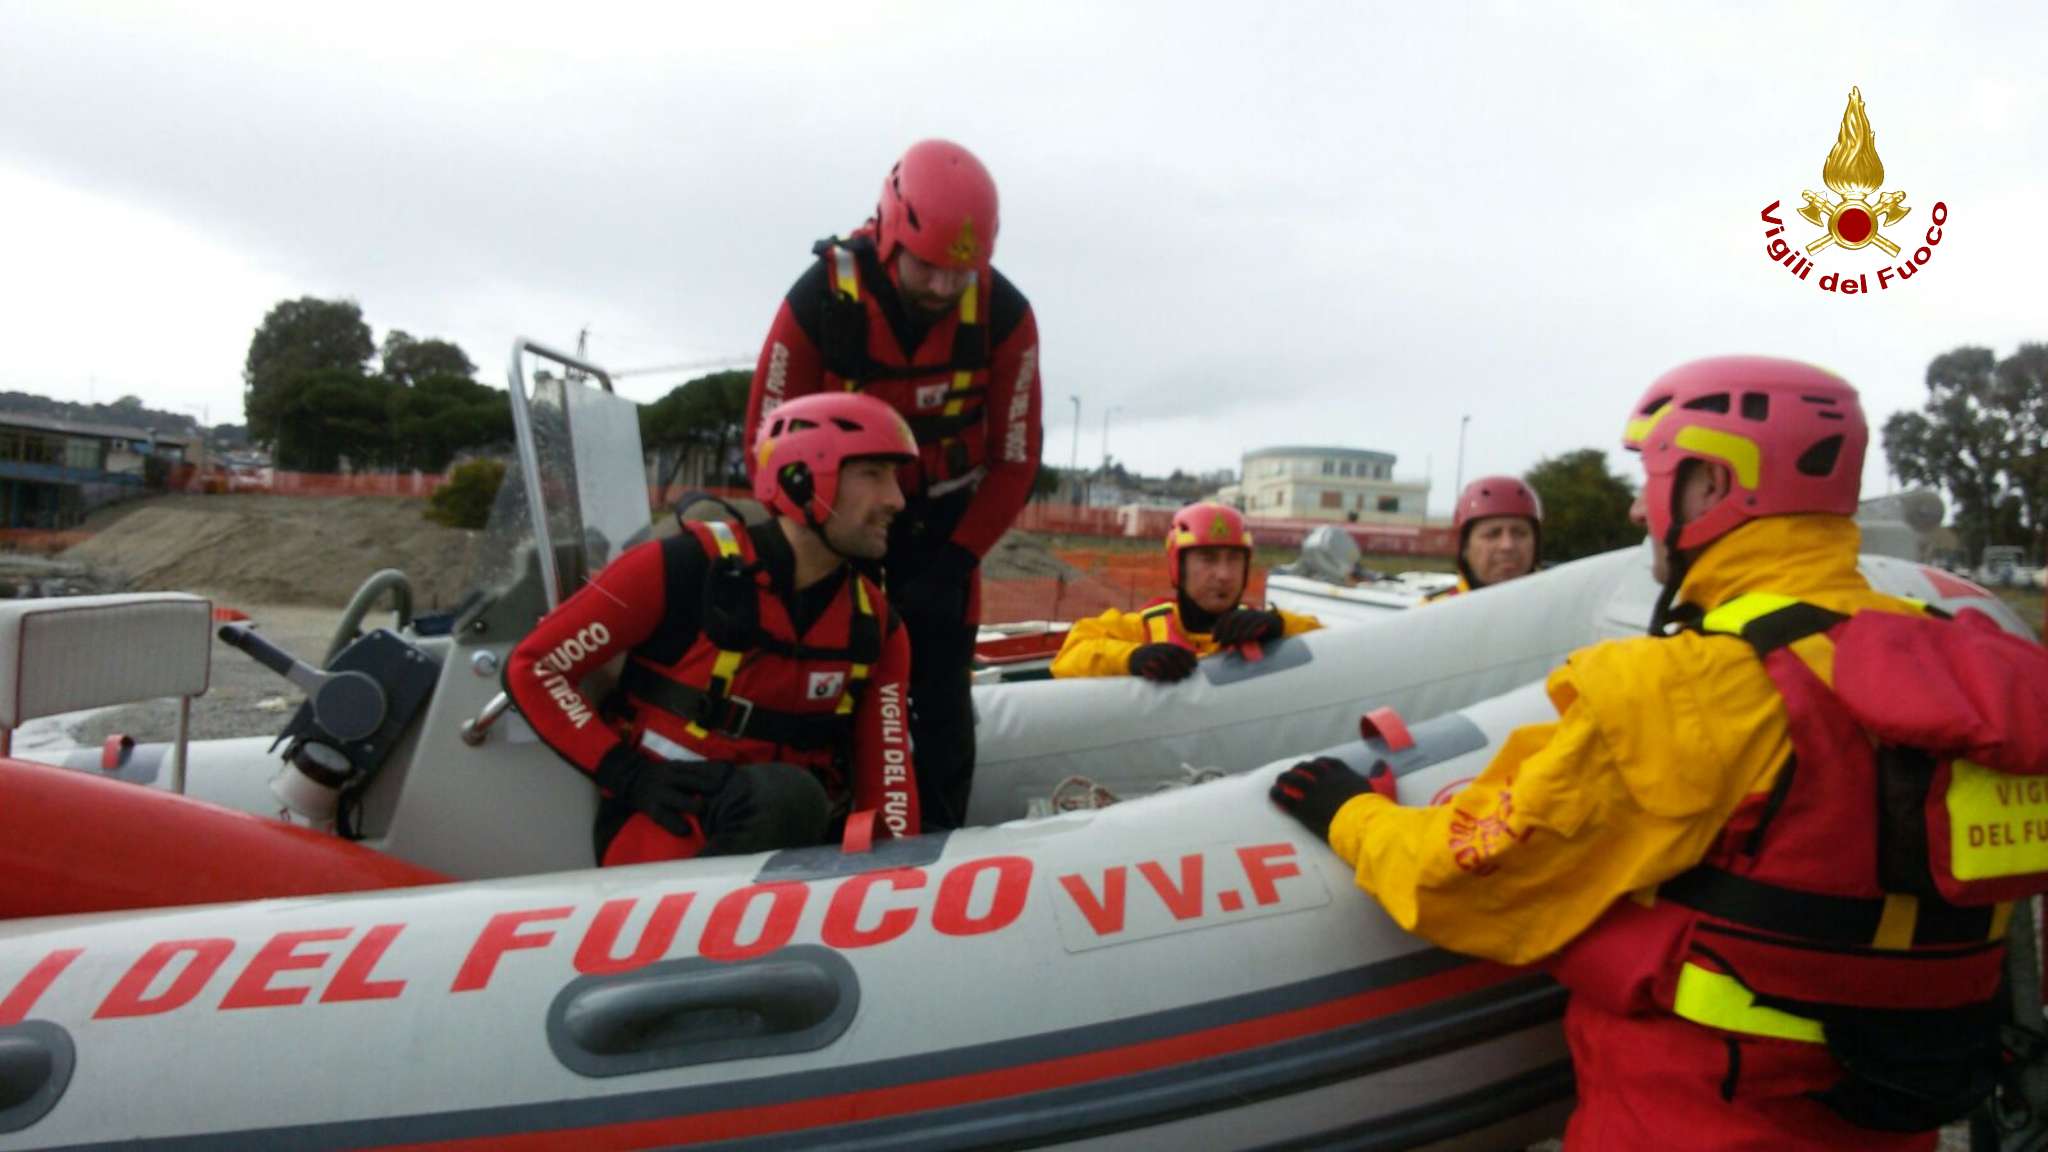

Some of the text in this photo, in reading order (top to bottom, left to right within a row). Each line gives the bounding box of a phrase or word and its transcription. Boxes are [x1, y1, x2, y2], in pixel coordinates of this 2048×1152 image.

[879, 683, 904, 743] VIGILI
[883, 749, 907, 786] DEL
[1967, 822, 2017, 848] DEL
[1059, 842, 1303, 937] VV.F
[91, 923, 409, 1020] DEL
[449, 855, 1034, 993] FUOCO
